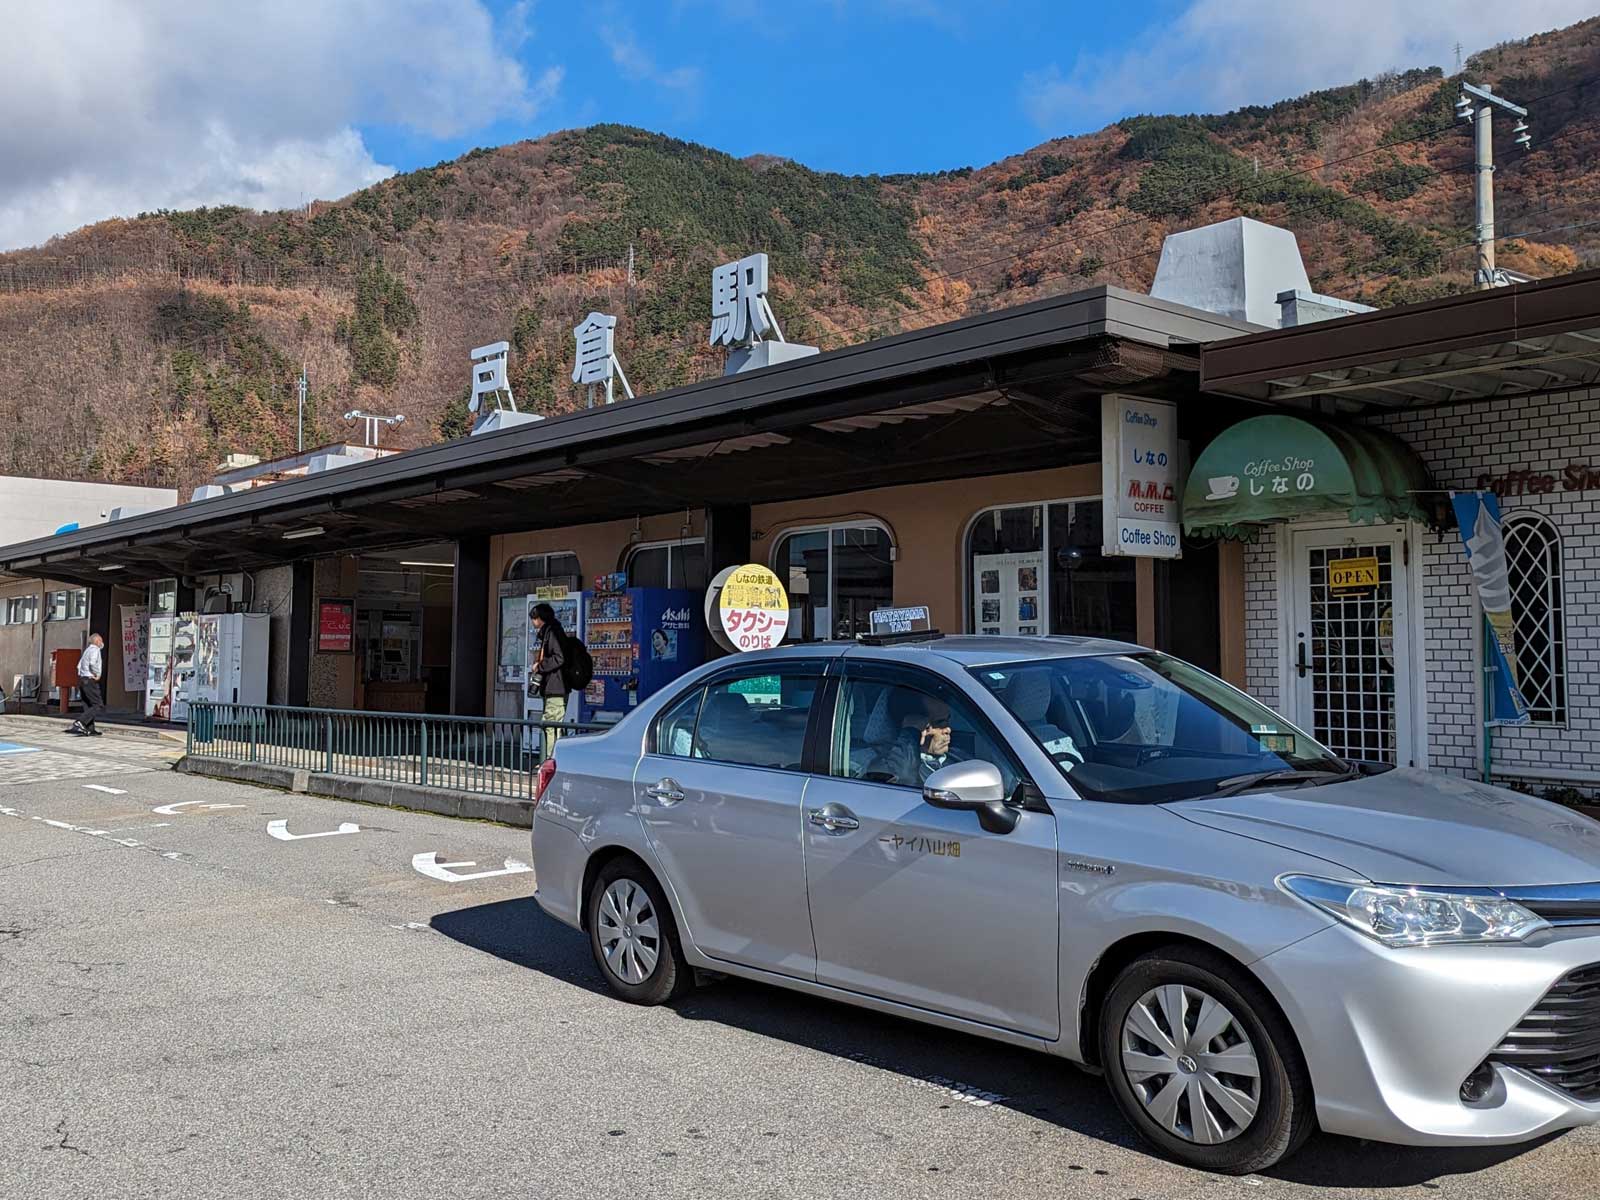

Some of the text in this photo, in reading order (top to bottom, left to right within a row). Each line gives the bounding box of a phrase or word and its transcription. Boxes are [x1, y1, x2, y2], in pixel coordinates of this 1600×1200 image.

[1134, 448, 1168, 467] しなの
[1244, 456, 1314, 477] Coffee Shop
[1250, 473, 1315, 496] しなの
[1134, 502, 1164, 514] COFFEE
[1121, 527, 1177, 548] Coffee Shop
[735, 574, 773, 585] しなの鉄道
[661, 607, 690, 622] Asahi
[726, 609, 786, 633] タクシー
[873, 608, 926, 623] HATAYAMA
[889, 620, 912, 633] TAXI
[739, 635, 773, 649] のりば
